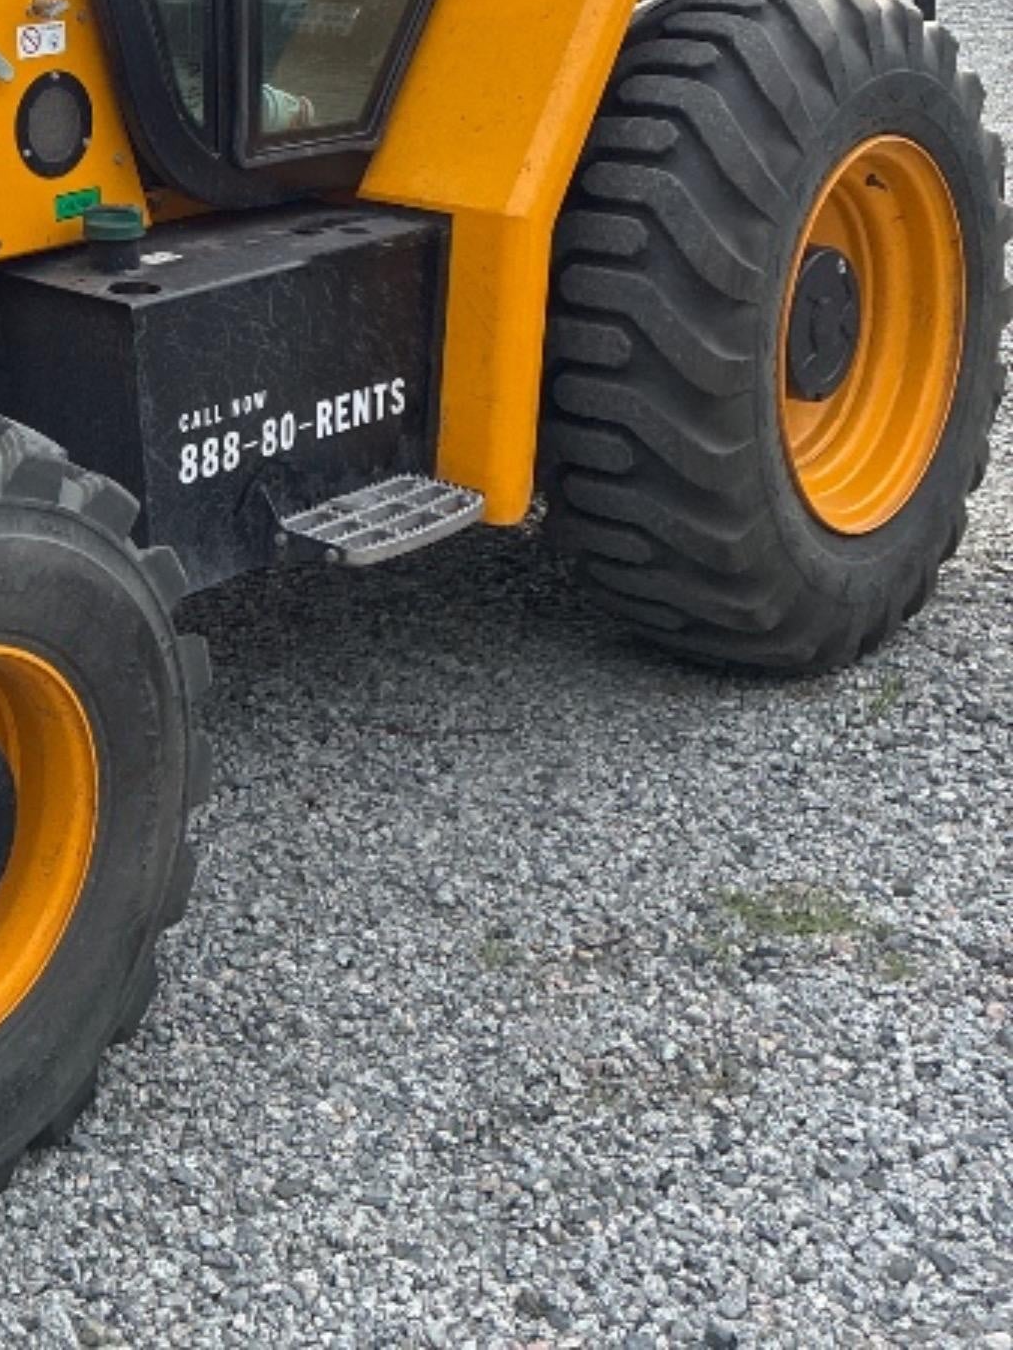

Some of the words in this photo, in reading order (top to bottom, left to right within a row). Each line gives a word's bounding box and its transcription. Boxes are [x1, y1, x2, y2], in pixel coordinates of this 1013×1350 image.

[178, 405, 222, 432] CALL
[232, 390, 267, 416] NOW
[178, 377, 406, 484] 888-80-RENTS
